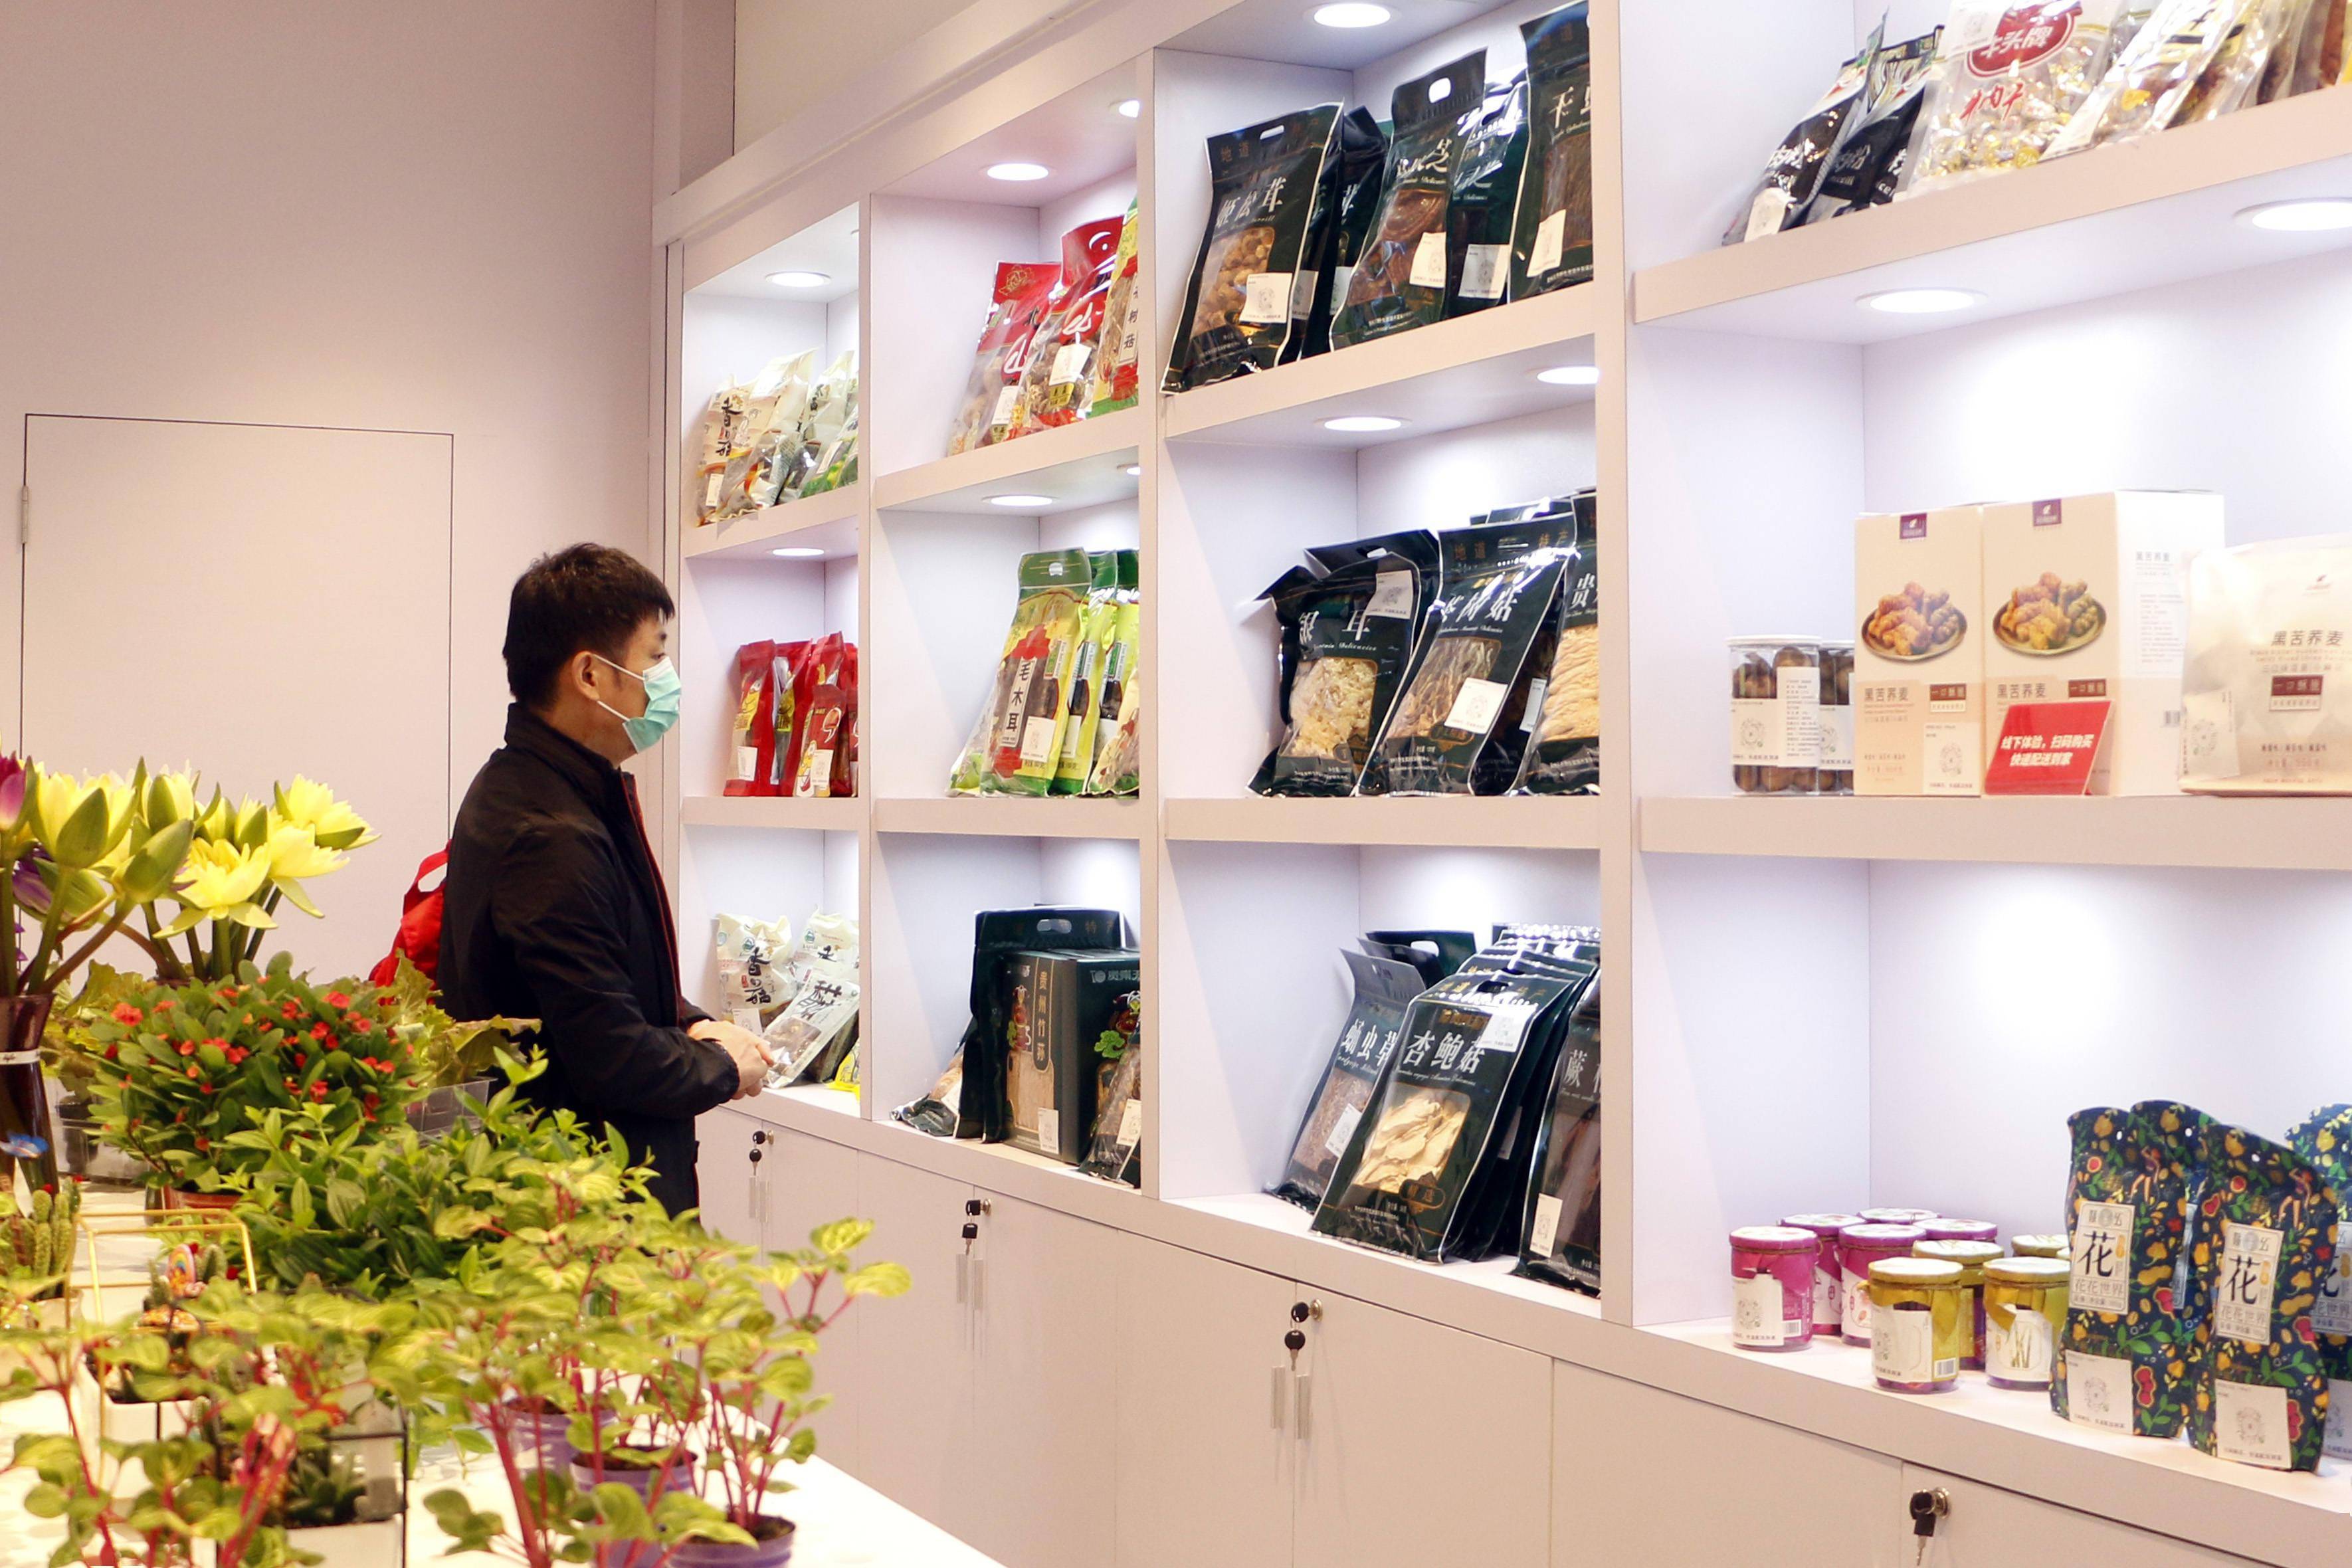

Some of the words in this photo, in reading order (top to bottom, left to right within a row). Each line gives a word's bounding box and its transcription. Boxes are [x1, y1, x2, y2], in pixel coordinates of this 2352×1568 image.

[1217, 177, 1287, 228] 姬松茸
[2271, 630, 2344, 646] 黑苦荞麦
[1006, 662, 1030, 732] 毛木耳
[1864, 686, 1909, 702] 黑苦荞麦
[1997, 683, 2046, 698] 黑苦荞麦
[2009, 751, 2074, 767] 快递配送到家
[1403, 1030, 1486, 1074] 杏鲍菇
[2077, 1230, 2115, 1278] 花
[2074, 1277, 2124, 1298] 花花世界
[2223, 1254, 2261, 1306] 花
[2220, 1304, 2266, 1325] 花花世界
